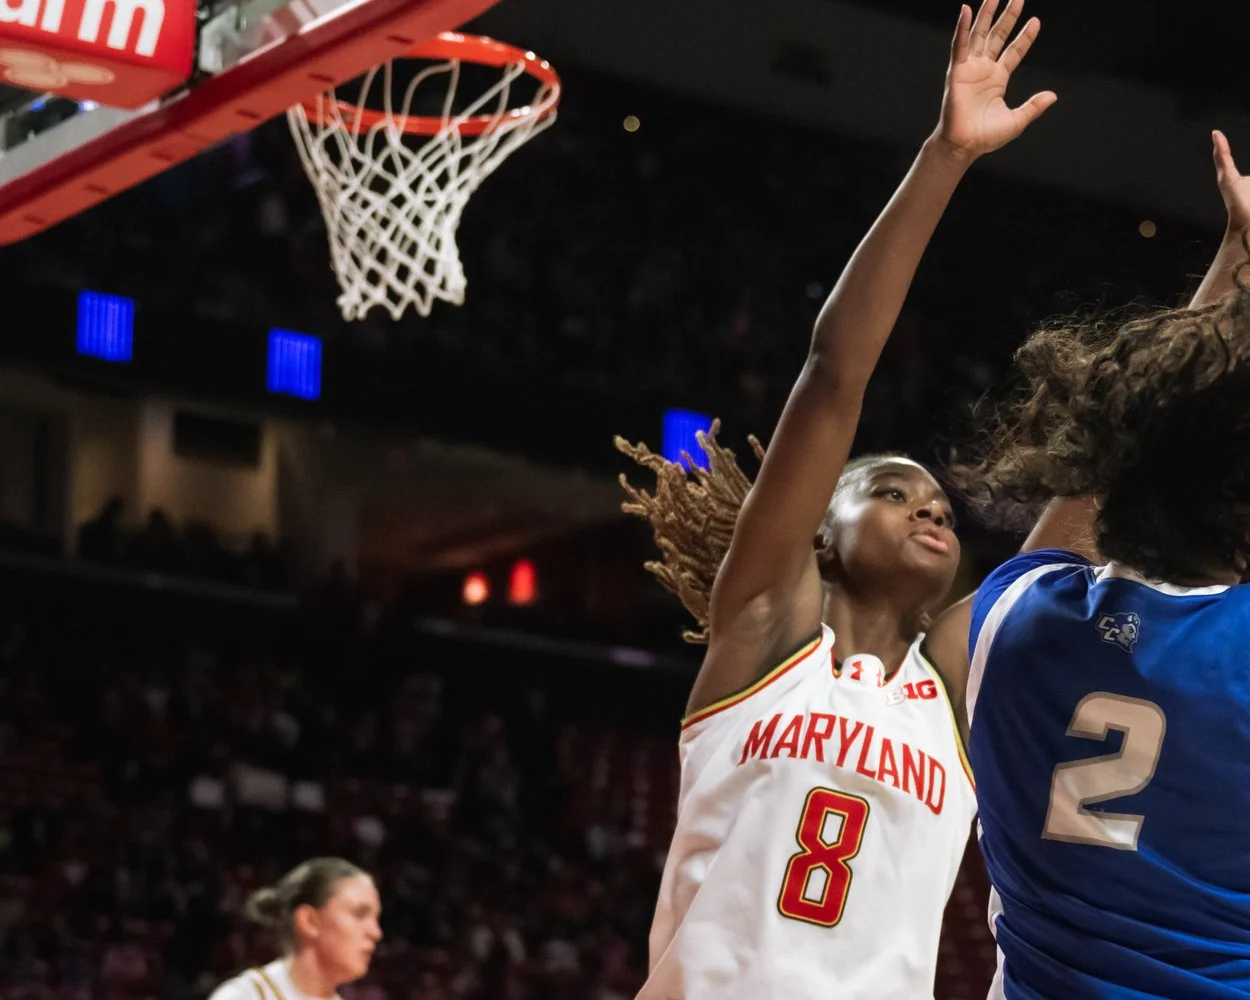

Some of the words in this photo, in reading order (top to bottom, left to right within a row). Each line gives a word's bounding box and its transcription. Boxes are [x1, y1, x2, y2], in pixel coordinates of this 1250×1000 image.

[736, 712, 946, 816] MARYLAND
[1041, 691, 1167, 851] 2
[777, 786, 871, 928] 8
